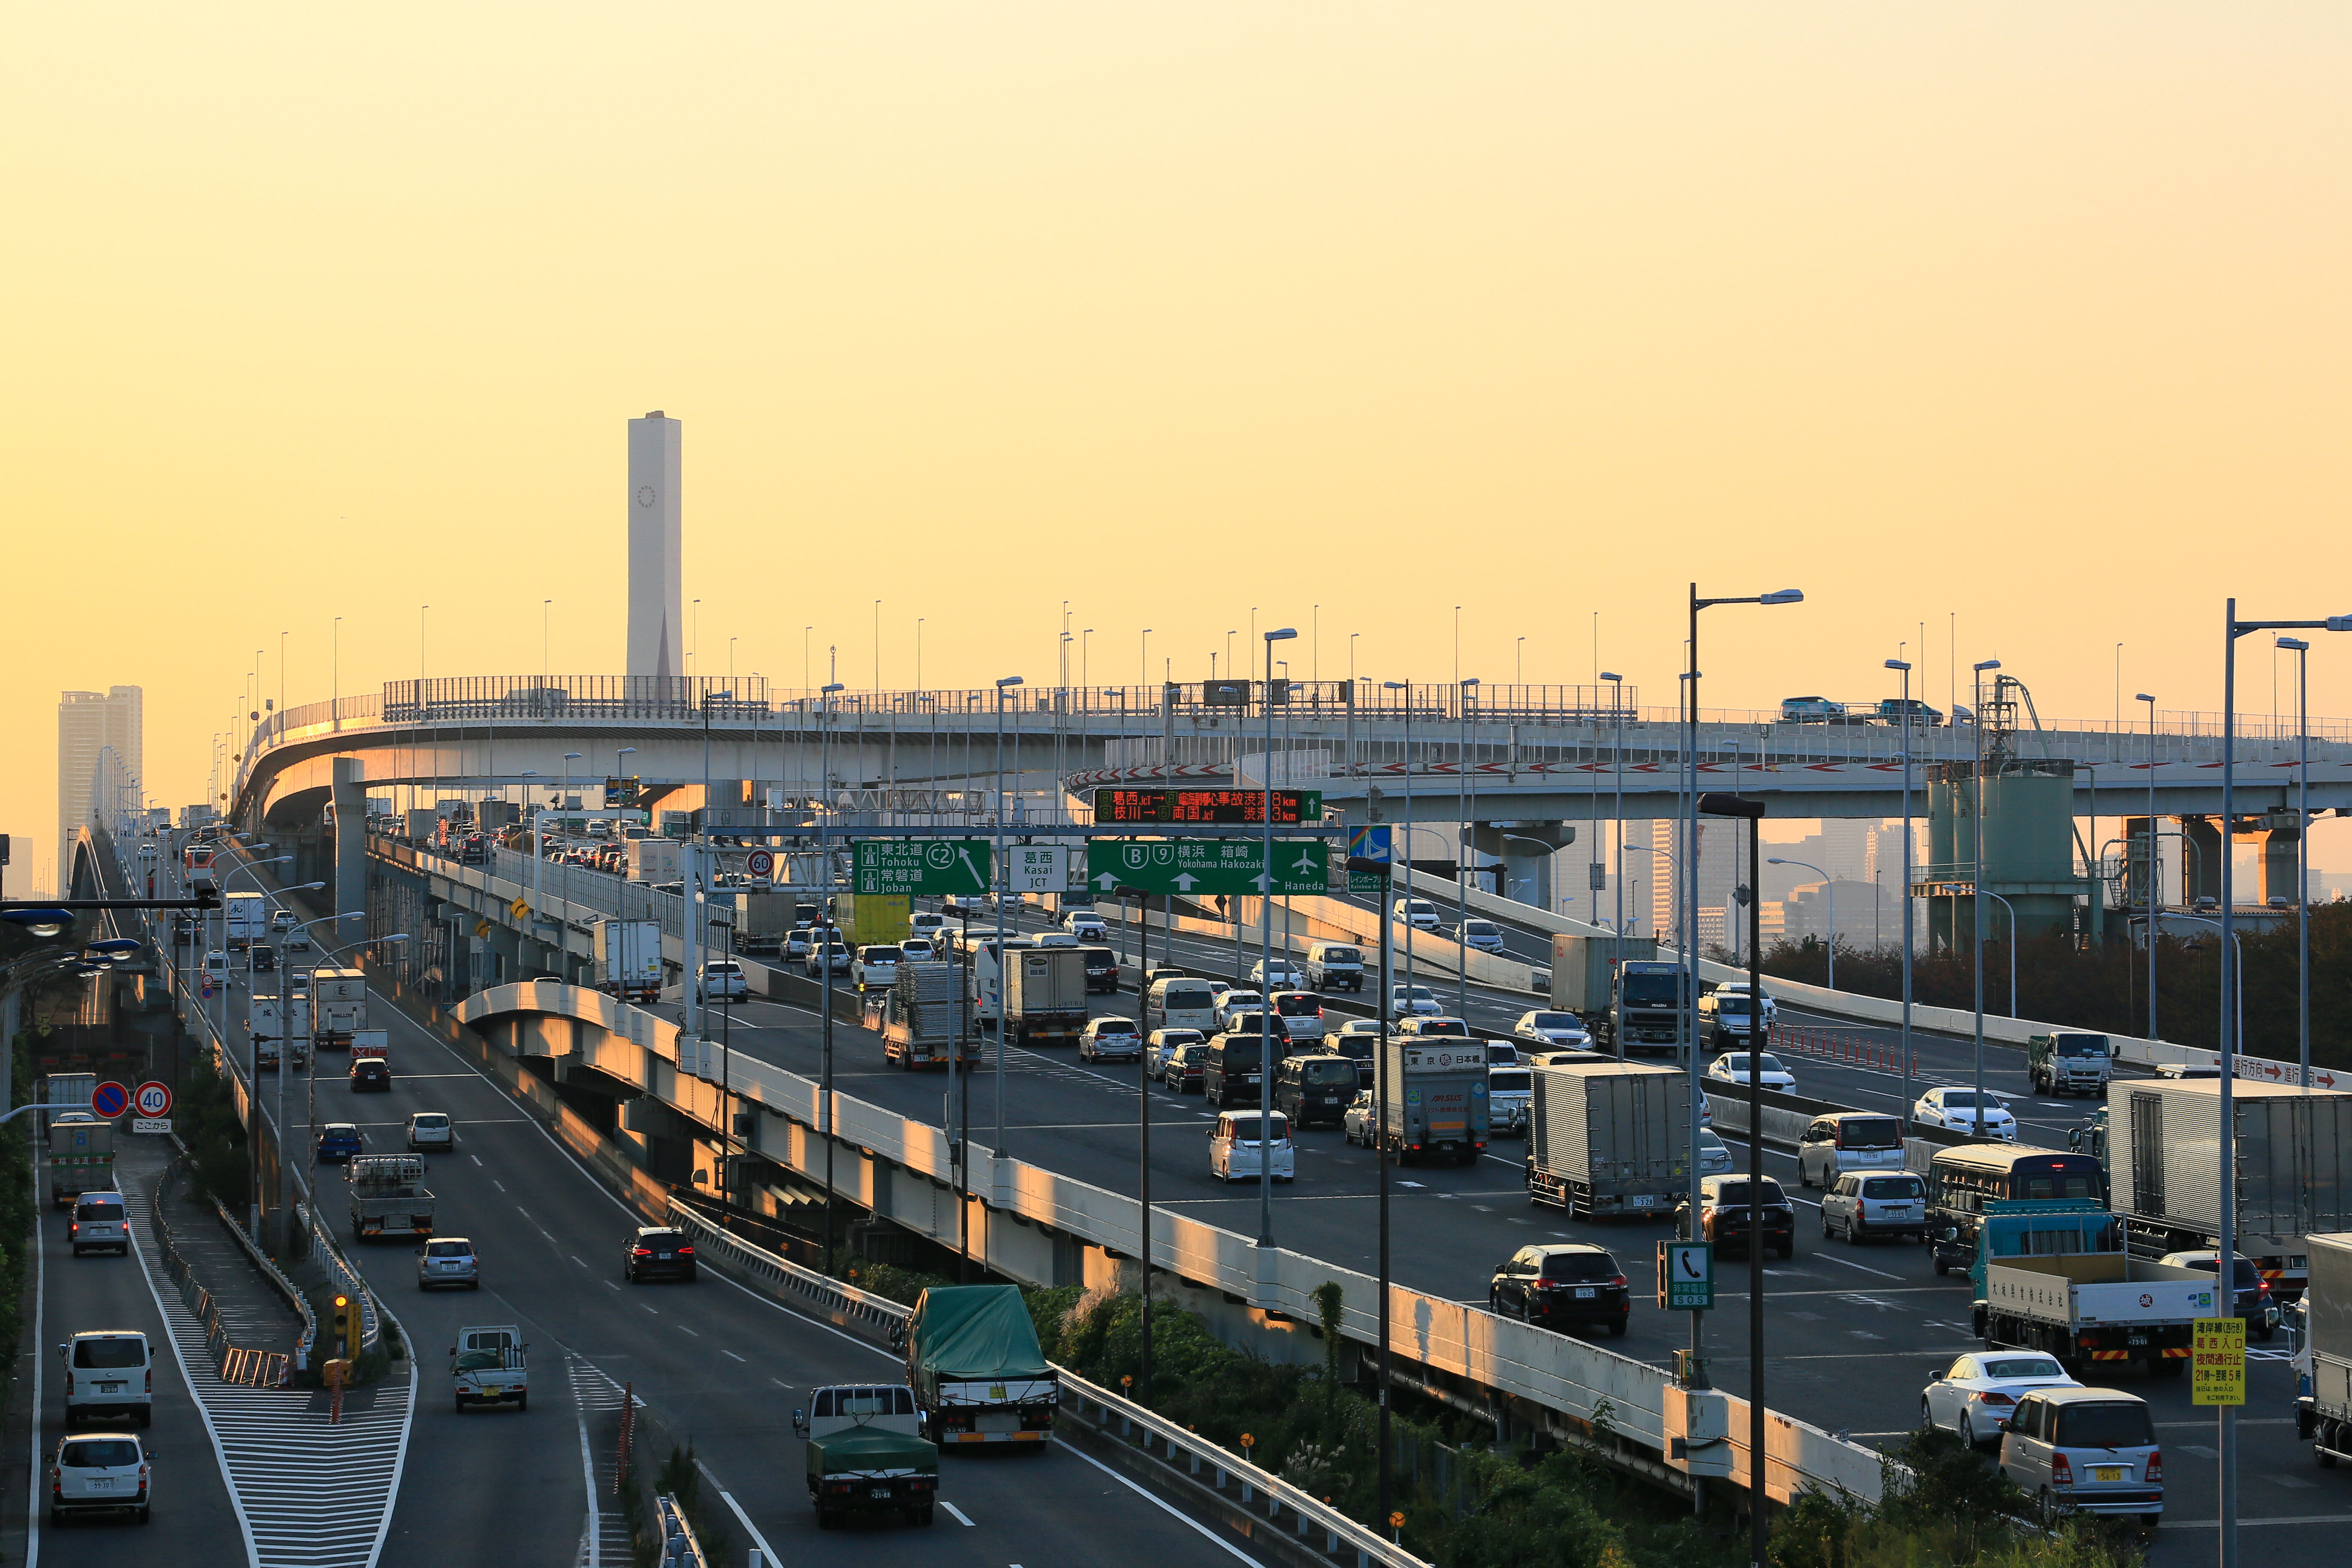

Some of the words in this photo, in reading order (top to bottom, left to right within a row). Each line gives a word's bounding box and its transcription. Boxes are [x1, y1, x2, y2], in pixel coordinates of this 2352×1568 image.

[1113, 792, 1138, 806] 葛西
[1114, 807, 1140, 820] 枝川
[1173, 807, 1200, 820] 両国
[881, 843, 923, 856] 東北道
[1159, 848, 1167, 860] 9
[1178, 845, 1205, 858] 横浜
[1221, 845, 1249, 858] 箱崎
[881, 858, 919, 866] Tohoku
[931, 849, 949, 863] C2
[1024, 851, 1052, 864] 葛西
[1131, 849, 1141, 863] B
[754, 857, 768, 869] 60
[1178, 859, 1217, 868] Yokohama
[1221, 859, 1264, 869] Hakozaki
[881, 869, 923, 882] 常磐道
[1024, 865, 1052, 874] Kasai
[881, 883, 911, 893] Joban
[1031, 878, 1047, 888] JCT
[1285, 881, 1324, 890] Haneda
[1456, 1055, 1479, 1063] 日本橋
[2234, 1058, 2263, 1078] 進行方向
[2285, 1066, 2315, 1086] 進行向
[143, 1092, 163, 1107] 40
[1673, 1283, 1707, 1294] 非常電話
[2140, 1294, 2152, 1306] 城
[2197, 1322, 2243, 1334] 湾岸線(西行き)
[2196, 1338, 2242, 1349] 葛西入口
[2196, 1353, 2241, 1365] 夜間通行止
